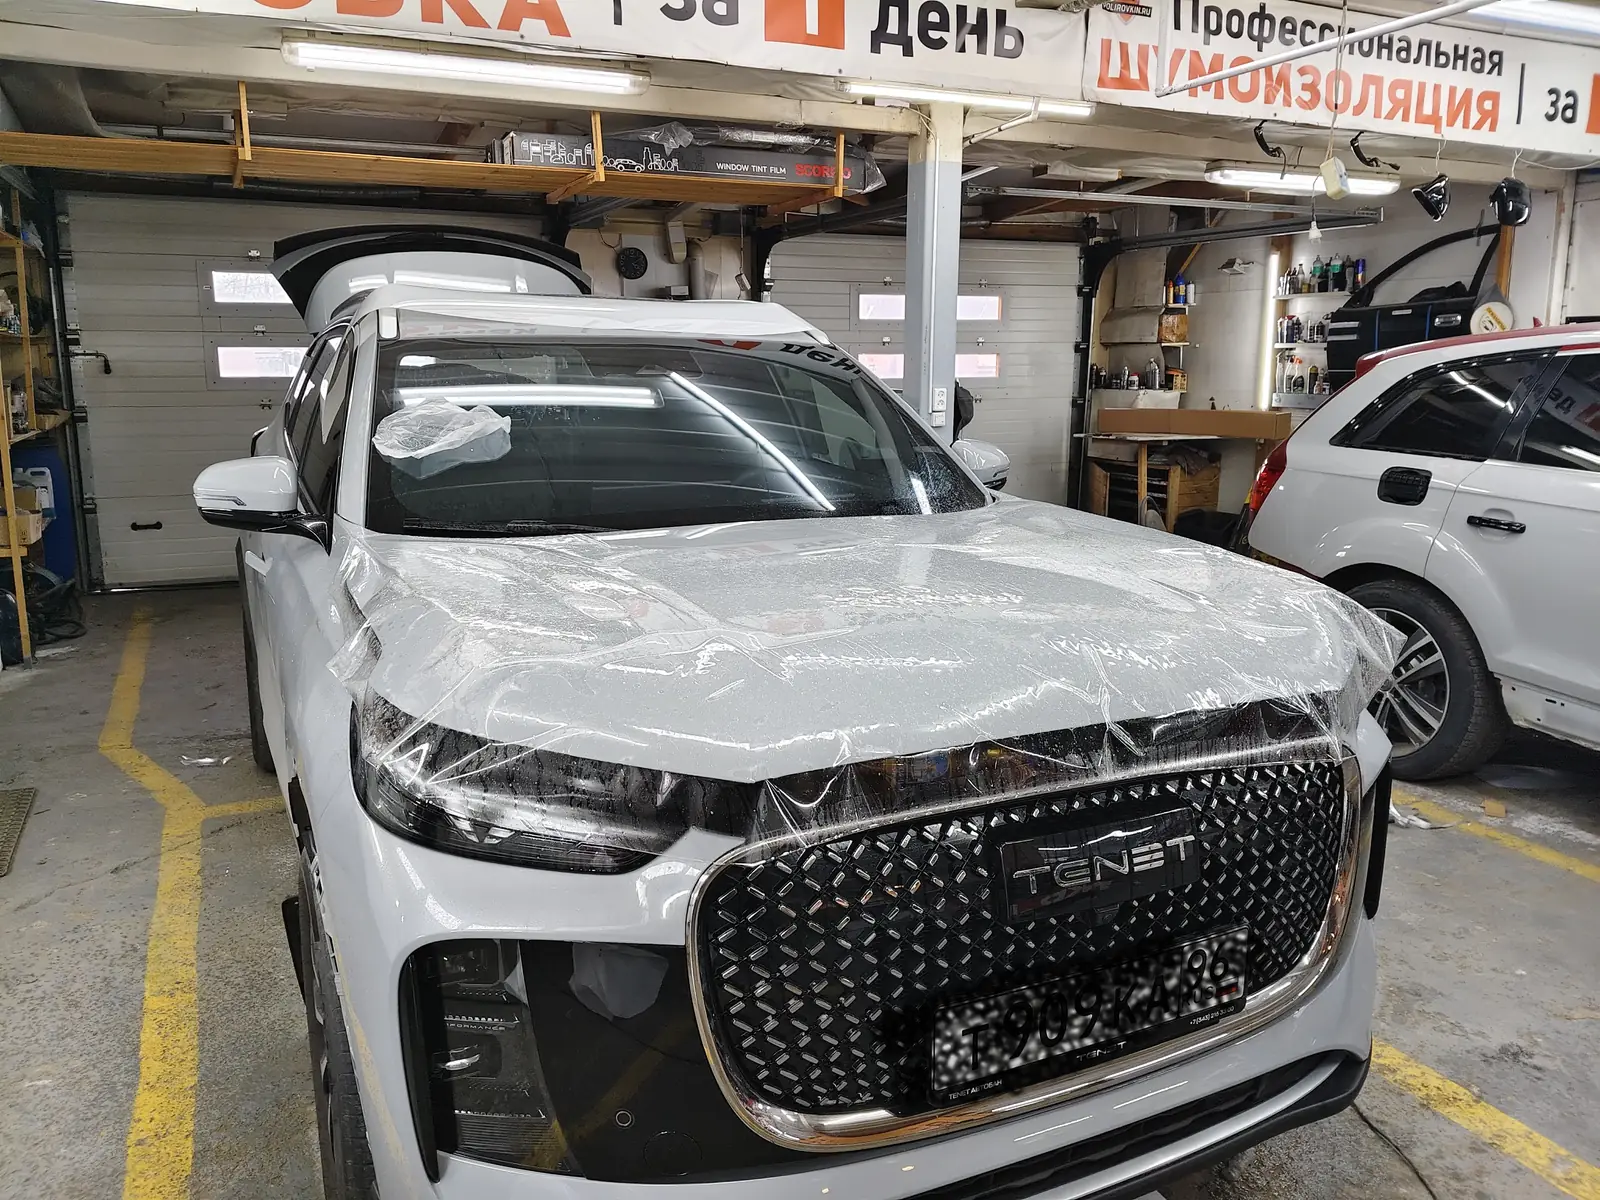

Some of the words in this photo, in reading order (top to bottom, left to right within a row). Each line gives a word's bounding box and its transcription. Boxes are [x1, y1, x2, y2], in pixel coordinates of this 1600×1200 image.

[870, 0, 1025, 59] день
[1544, 87, 1579, 124] за
[716, 162, 749, 172] WINDOW
[751, 164, 767, 173] TINT
[769, 166, 787, 174] FILM
[1013, 835, 1195, 894] TENET
[1076, 1041, 1127, 1061] TENT
